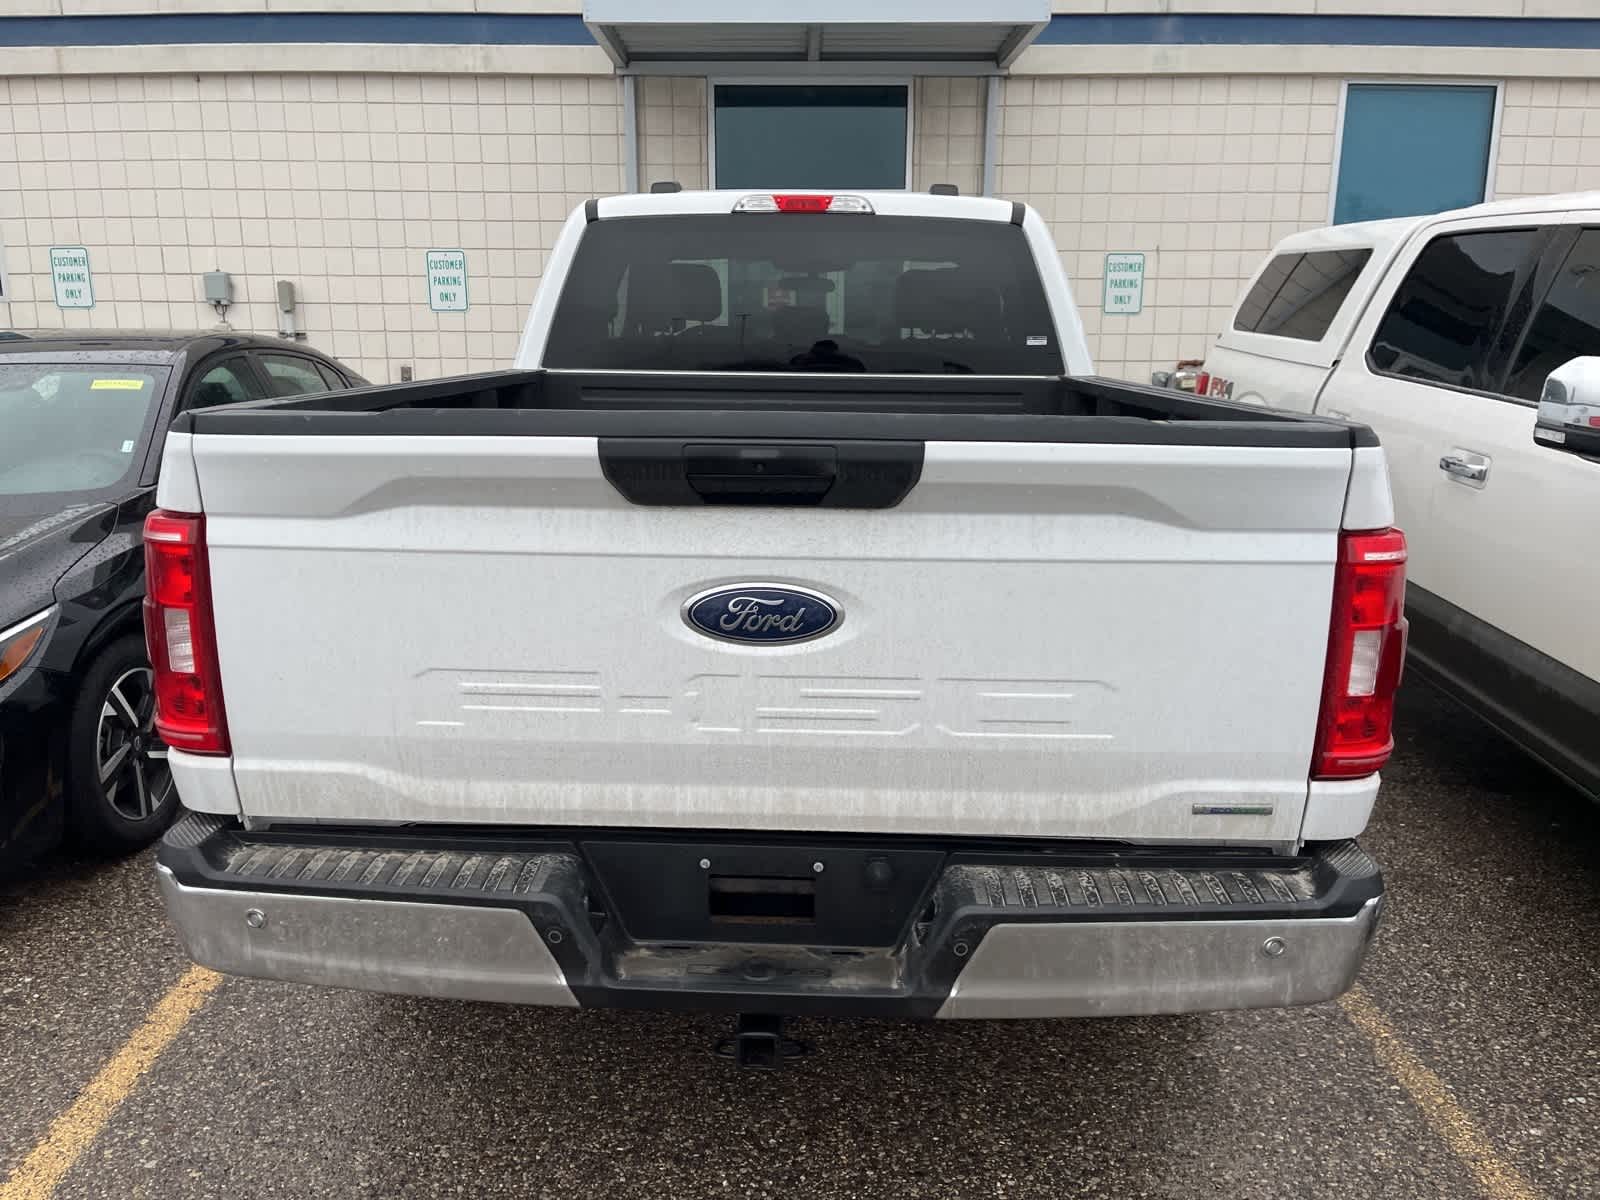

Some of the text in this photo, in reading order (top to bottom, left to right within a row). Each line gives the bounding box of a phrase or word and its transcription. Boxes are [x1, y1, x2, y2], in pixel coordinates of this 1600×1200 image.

[53, 256, 86, 267] CUSTOMER
[430, 259, 463, 270] CUSTOMER
[1108, 262, 1142, 272] CUSTOMER
[58, 272, 86, 282] PARKING
[433, 276, 462, 286] PARKING
[1110, 279, 1138, 289] PARKING
[65, 288, 82, 298] ONLY
[439, 292, 457, 302] ONLY
[1114, 295, 1132, 305] ONLY
[719, 596, 806, 632] Ford
